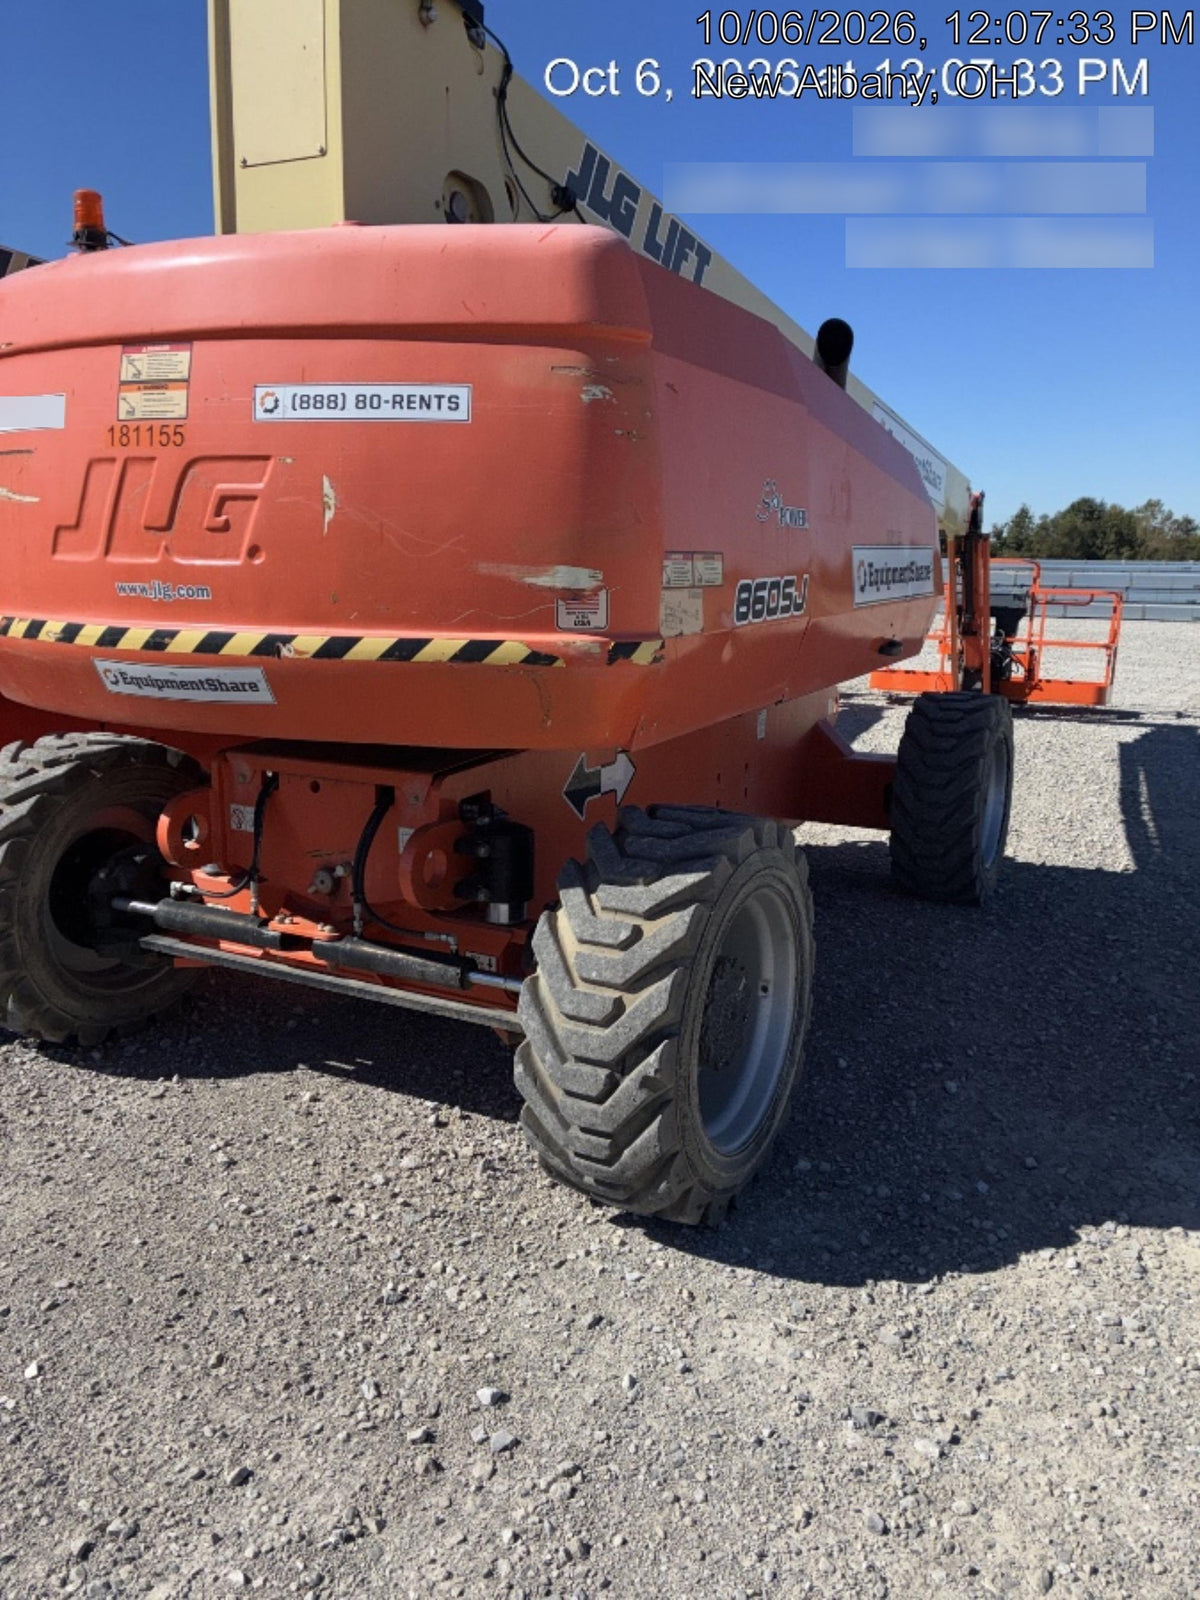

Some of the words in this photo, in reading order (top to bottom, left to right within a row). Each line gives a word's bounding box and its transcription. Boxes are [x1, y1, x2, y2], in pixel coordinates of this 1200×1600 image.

[563, 140, 641, 240] JLG
[643, 201, 712, 287] LIFT
[291, 392, 347, 412] (888)
[355, 393, 461, 412] 80-RENTS
[107, 424, 186, 448] 181155
[115, 580, 212, 601] www.jlg.com
[734, 574, 809, 625] 860SJ
[119, 671, 261, 692] EquipmentShare
